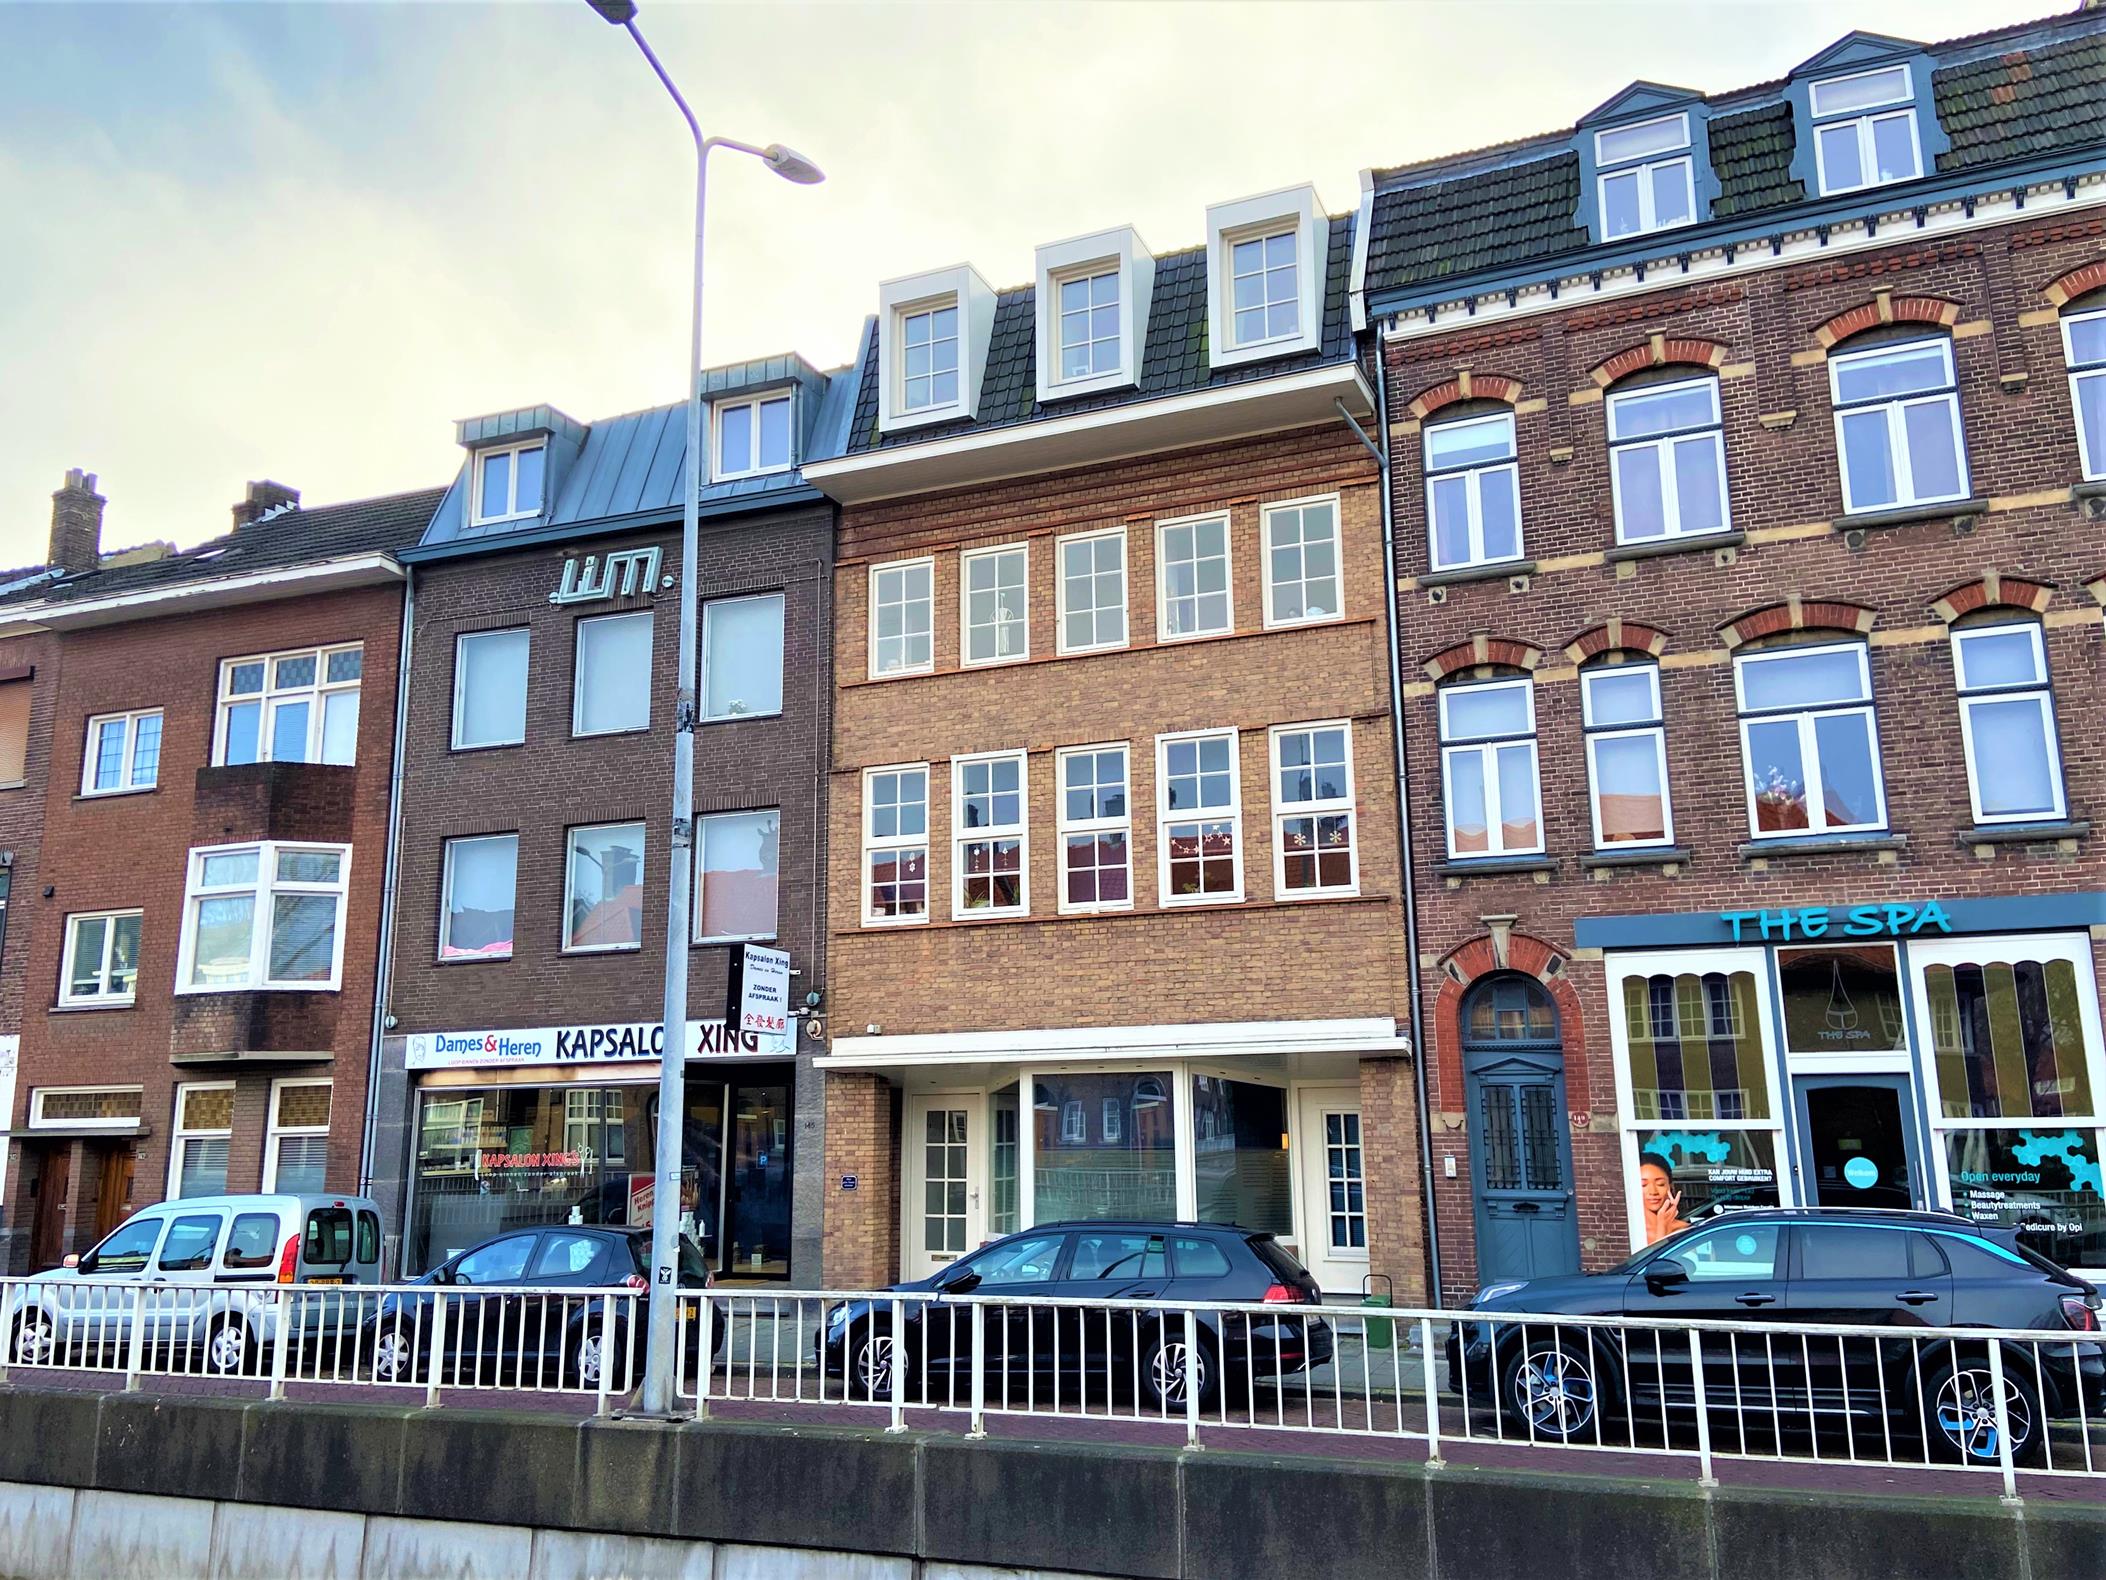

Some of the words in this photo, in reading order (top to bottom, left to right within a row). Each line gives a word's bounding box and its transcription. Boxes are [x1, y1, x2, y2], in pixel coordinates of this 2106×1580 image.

[1720, 907, 1830, 942] THE
[1843, 900, 1953, 936] SPA
[745, 952, 774, 964] Kapsalon
[774, 956, 789, 969] Xing
[753, 984, 777, 994] ZONDER
[748, 992, 779, 1003] AFSPRAAK
[1817, 1030, 1844, 1040] THE
[1846, 1030, 1871, 1040] SPA
[435, 1035, 483, 1054] Dames
[484, 1035, 498, 1053] &
[499, 1038, 542, 1057] Heren
[556, 1026, 665, 1060] KAPSALO
[698, 1022, 759, 1054] XING
[481, 1153, 540, 1168] KAPSALON
[1753, 1168, 1773, 1176] EXTRA
[1961, 1171, 1989, 1183] Open
[1991, 1171, 2041, 1184] everyday
[1969, 1190, 2005, 1200] Massage
[1971, 1201, 2041, 1211] Beautytreatments
[1971, 1212, 1999, 1221] Waxen
[2056, 1223, 2067, 1233] by
